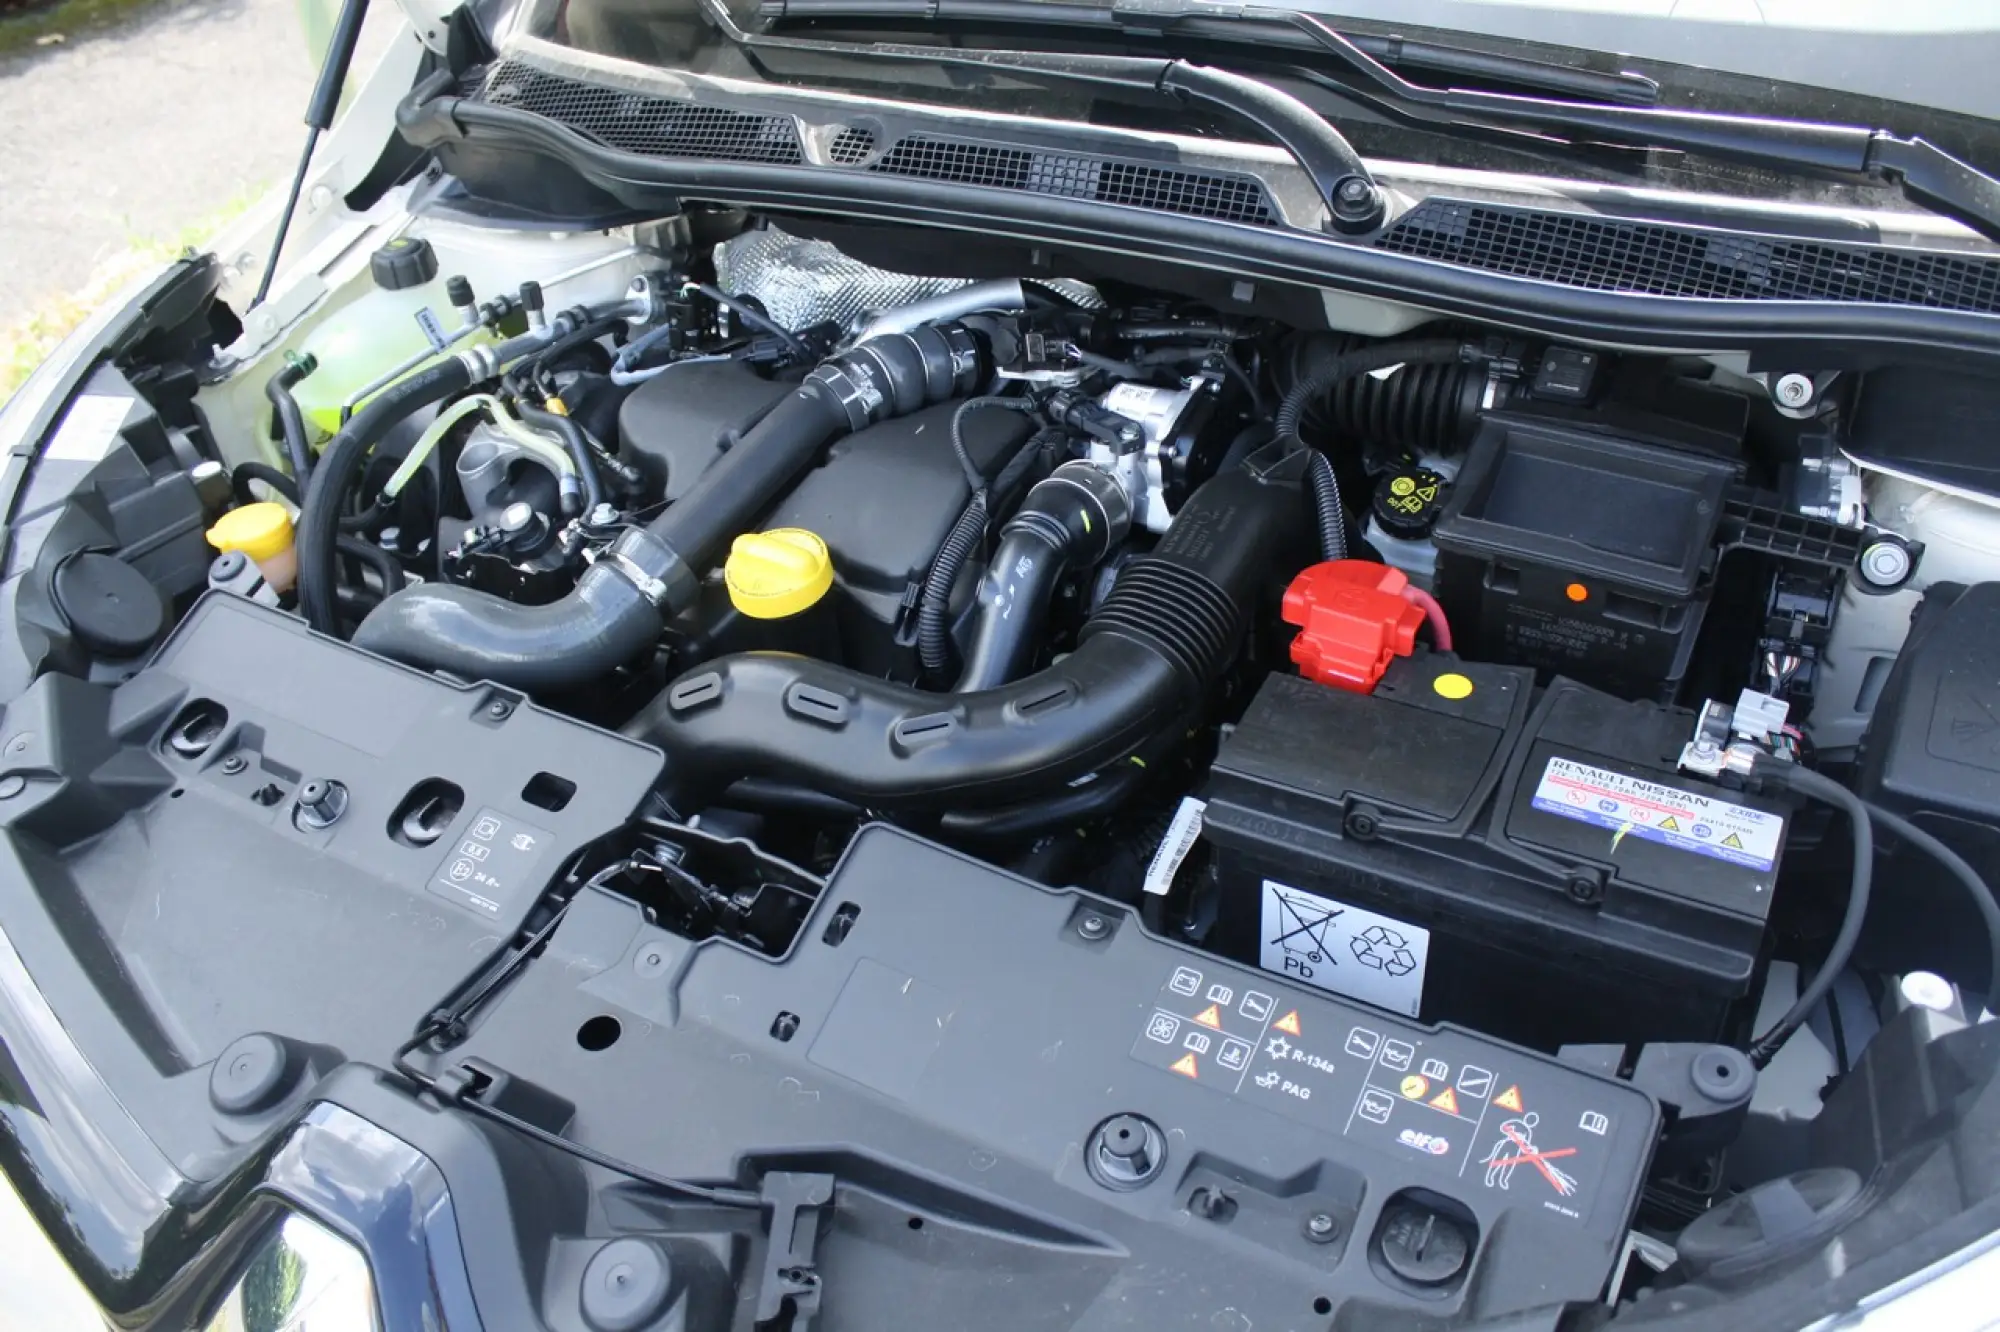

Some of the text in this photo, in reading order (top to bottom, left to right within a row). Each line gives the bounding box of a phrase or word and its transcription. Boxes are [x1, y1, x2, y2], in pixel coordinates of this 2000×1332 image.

[1553, 760, 1709, 807] RENAULT NISSAN
[1284, 955, 1313, 978] Pb
[1292, 1049, 1335, 1073] R-134a
[1281, 1080, 1311, 1100] PAG
